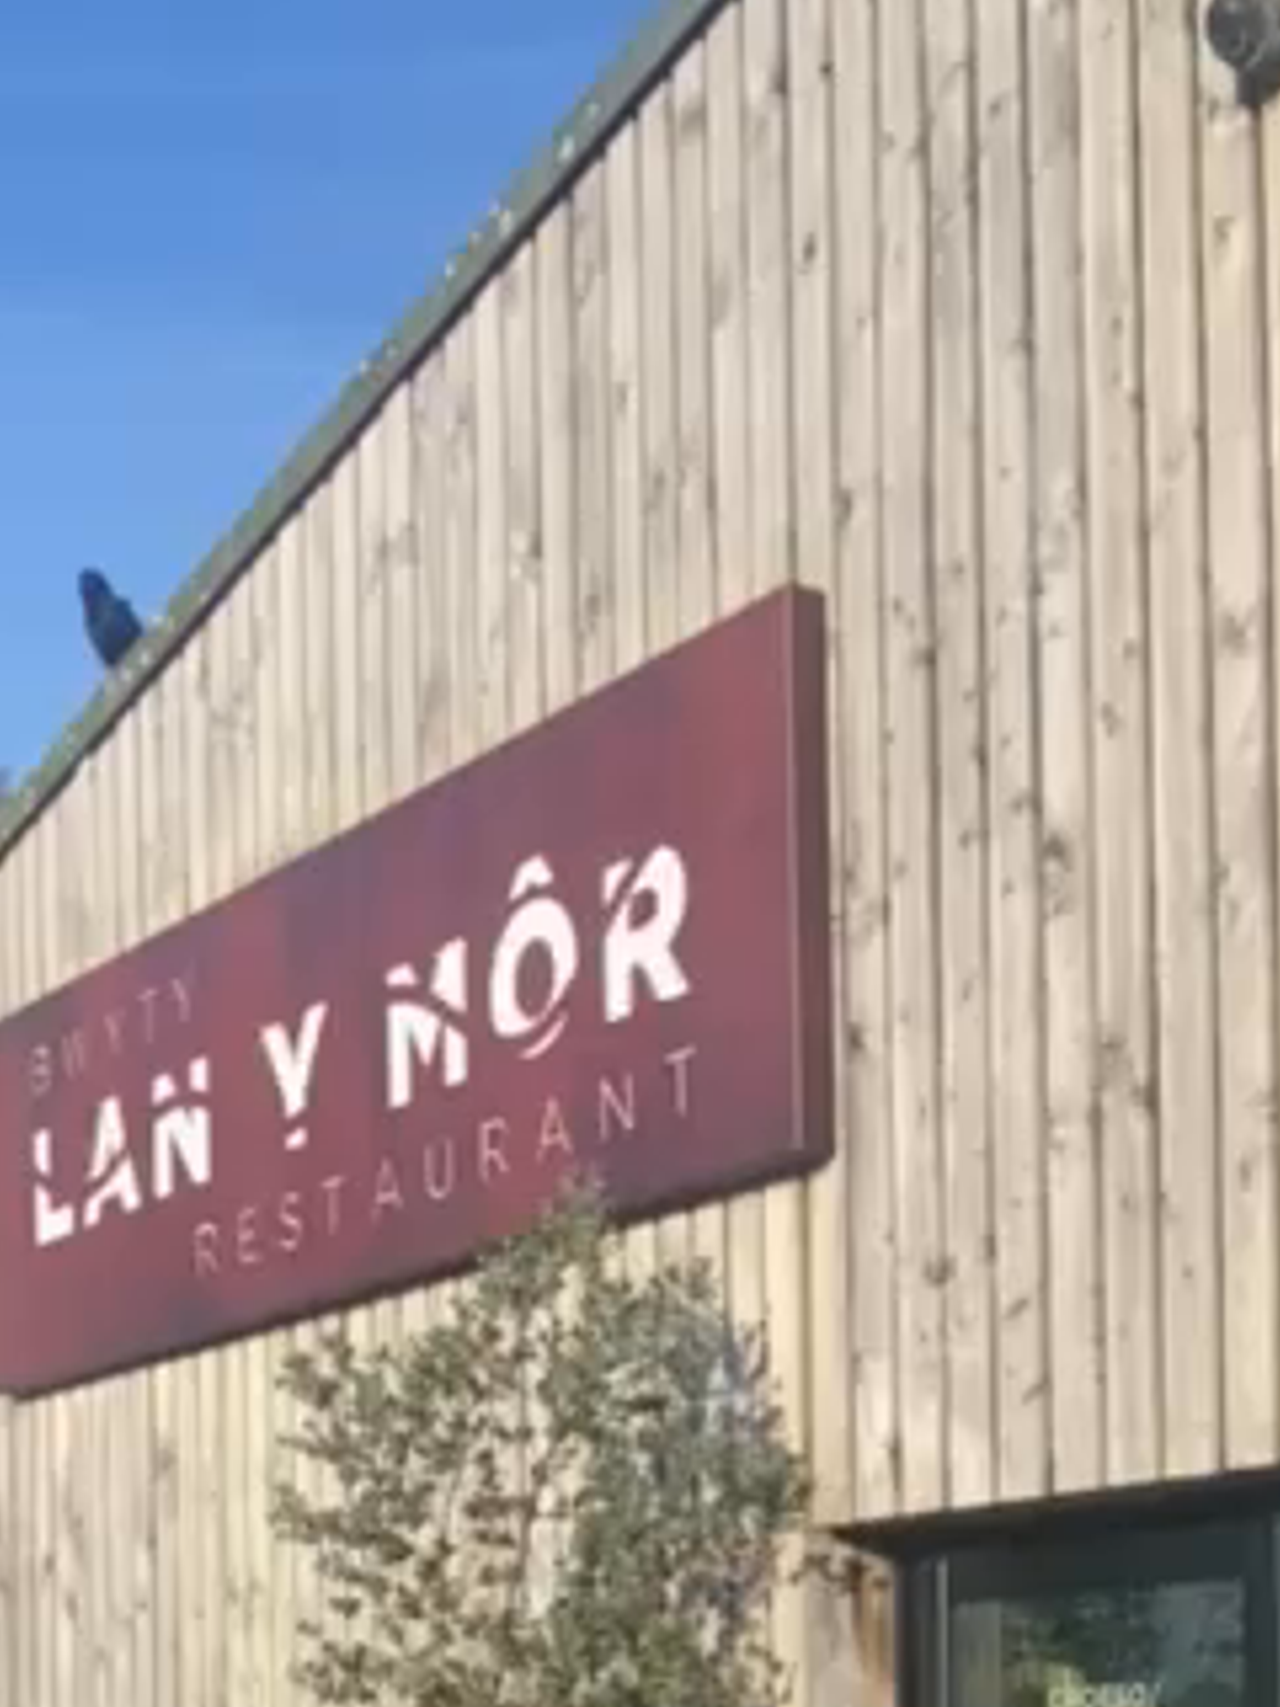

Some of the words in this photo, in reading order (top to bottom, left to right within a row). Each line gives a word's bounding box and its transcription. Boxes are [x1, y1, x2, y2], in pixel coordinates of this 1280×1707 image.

[33, 1056, 211, 1248] LAN
[259, 1001, 328, 1150] Y
[385, 844, 690, 1110] MÔR
[193, 1045, 696, 1278] RESTAURANT
